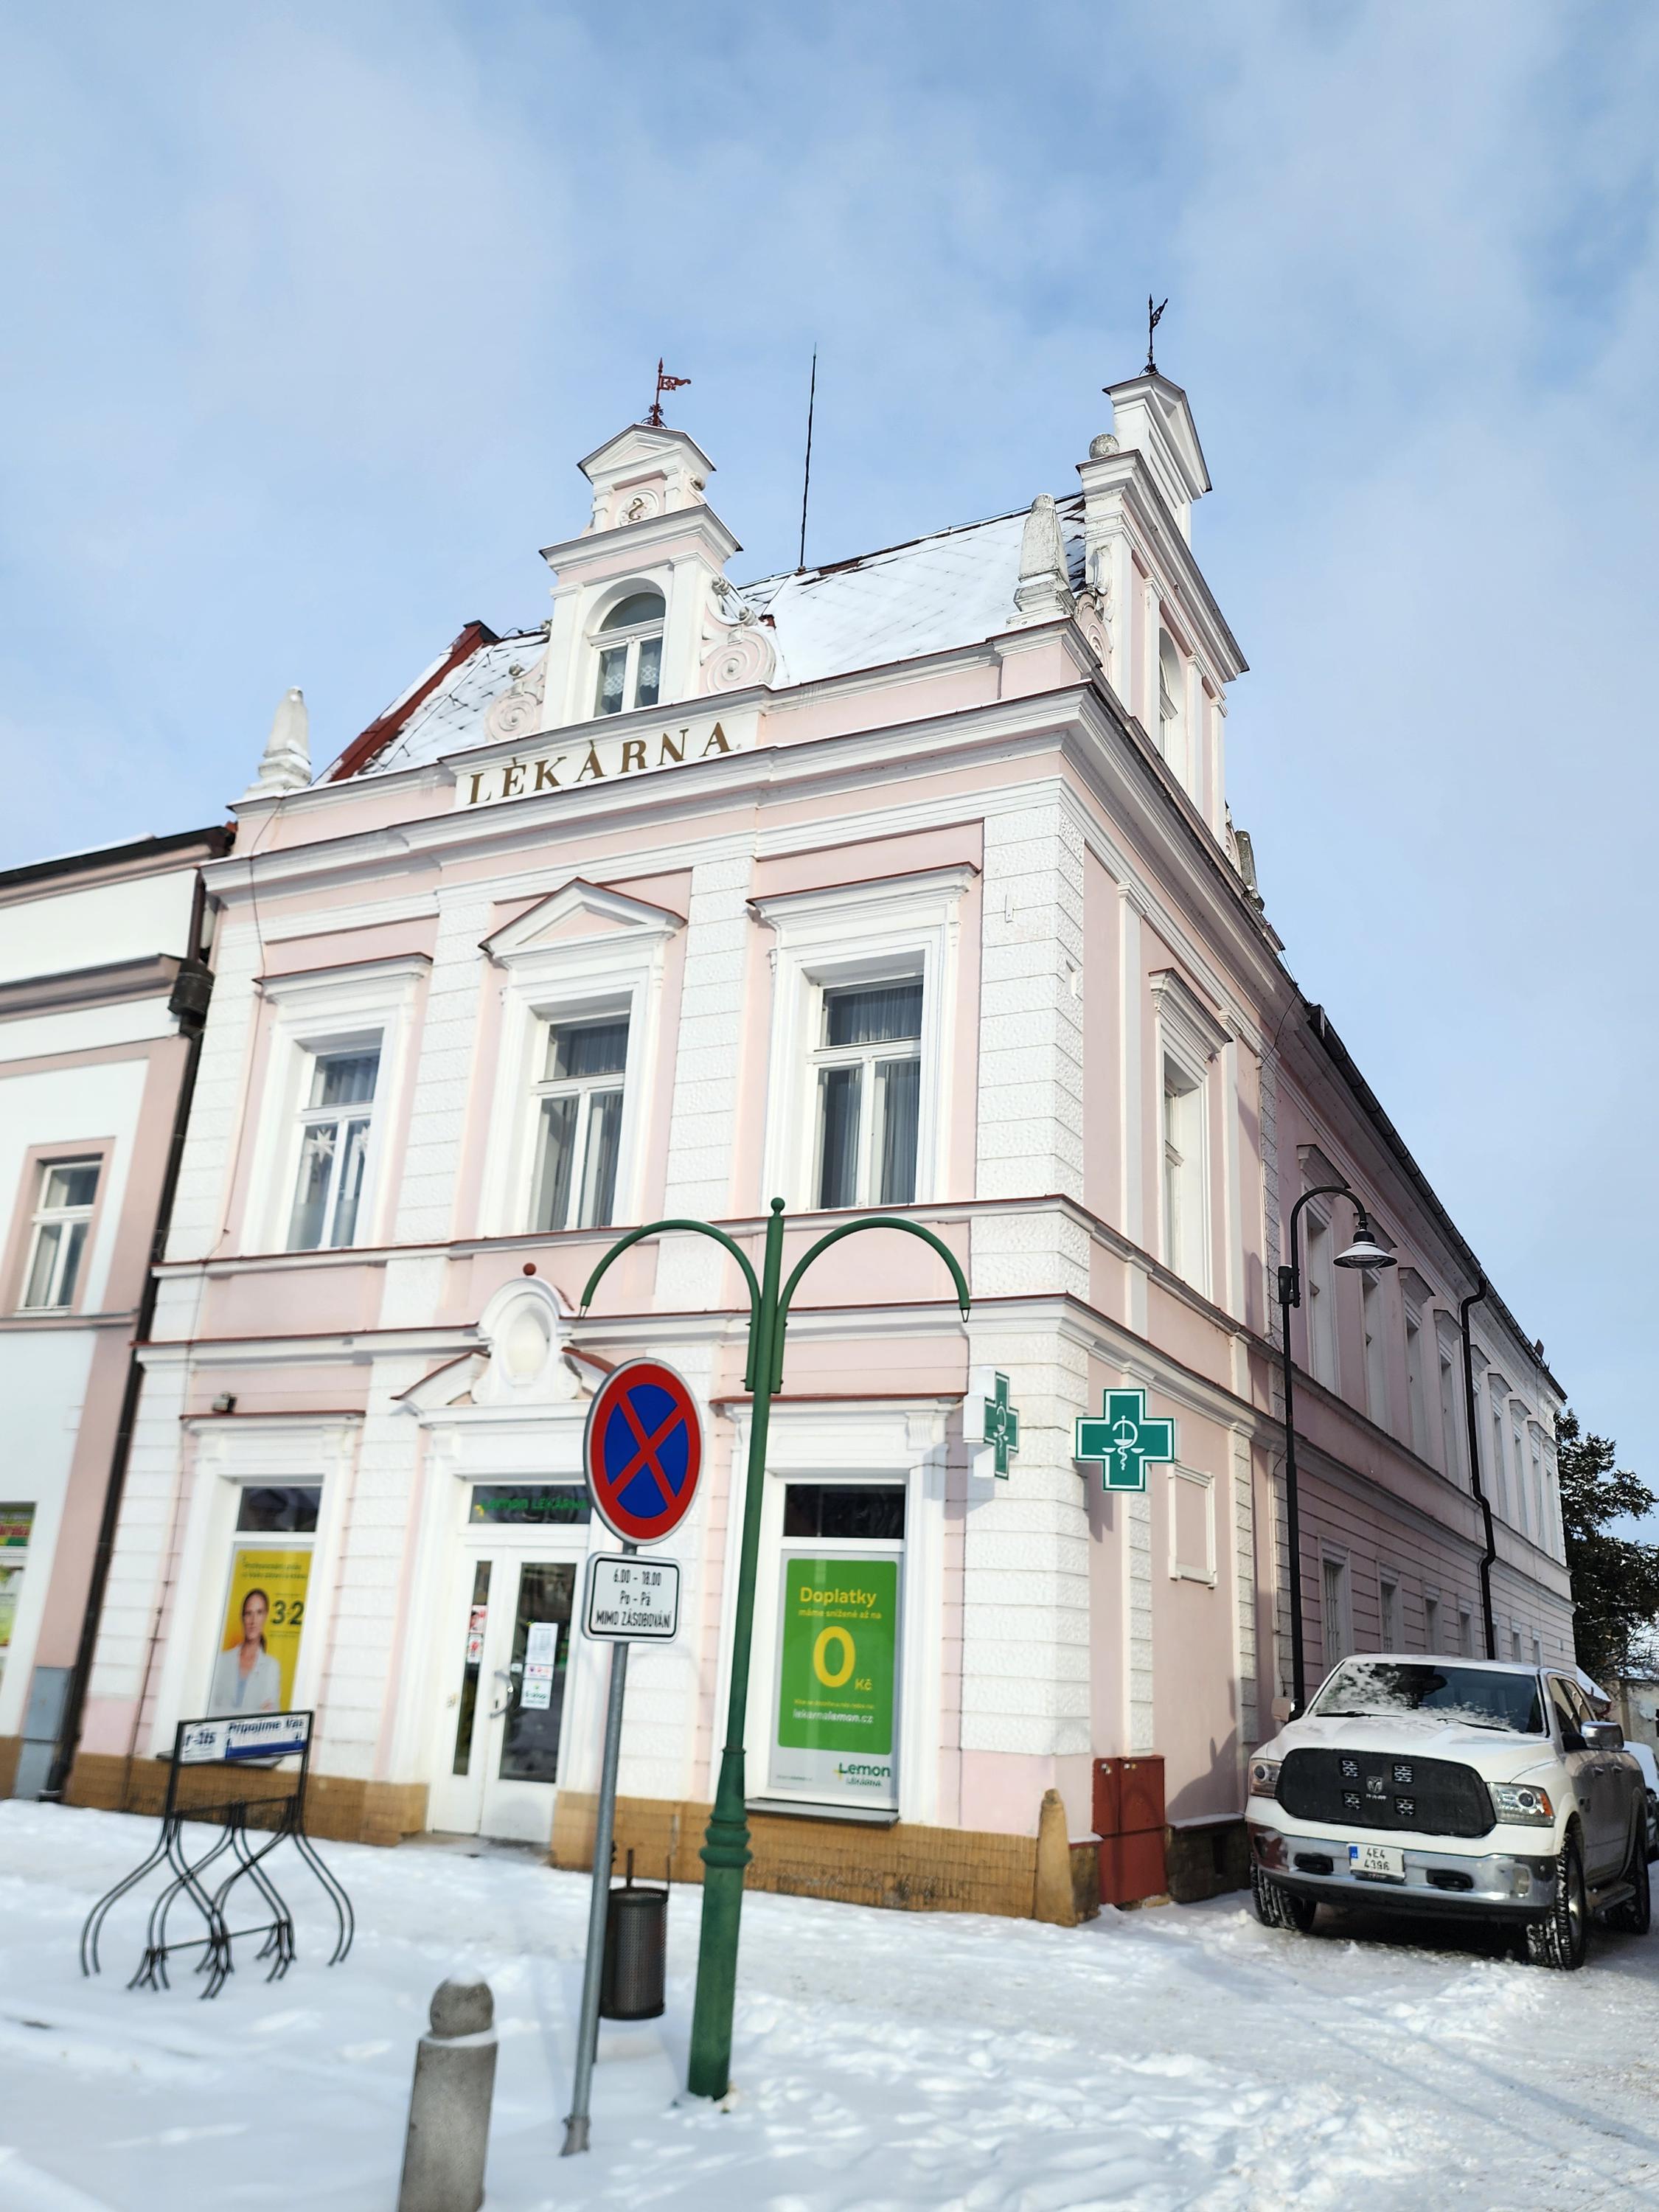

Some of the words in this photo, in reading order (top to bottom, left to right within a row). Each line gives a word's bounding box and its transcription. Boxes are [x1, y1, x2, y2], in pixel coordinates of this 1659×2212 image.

[466, 721, 734, 805] LÉKÁRNA
[613, 1568, 631, 1584] 6.00
[619, 1590, 630, 1604] Po
[800, 1586, 877, 1608] Doplatky
[596, 1610, 619, 1625] MIMO
[813, 1626, 855, 1688] 0
[855, 1677, 872, 1691] Kč
[839, 1762, 891, 1778] Lemon
[1366, 1848, 1385, 1859] 4E4
